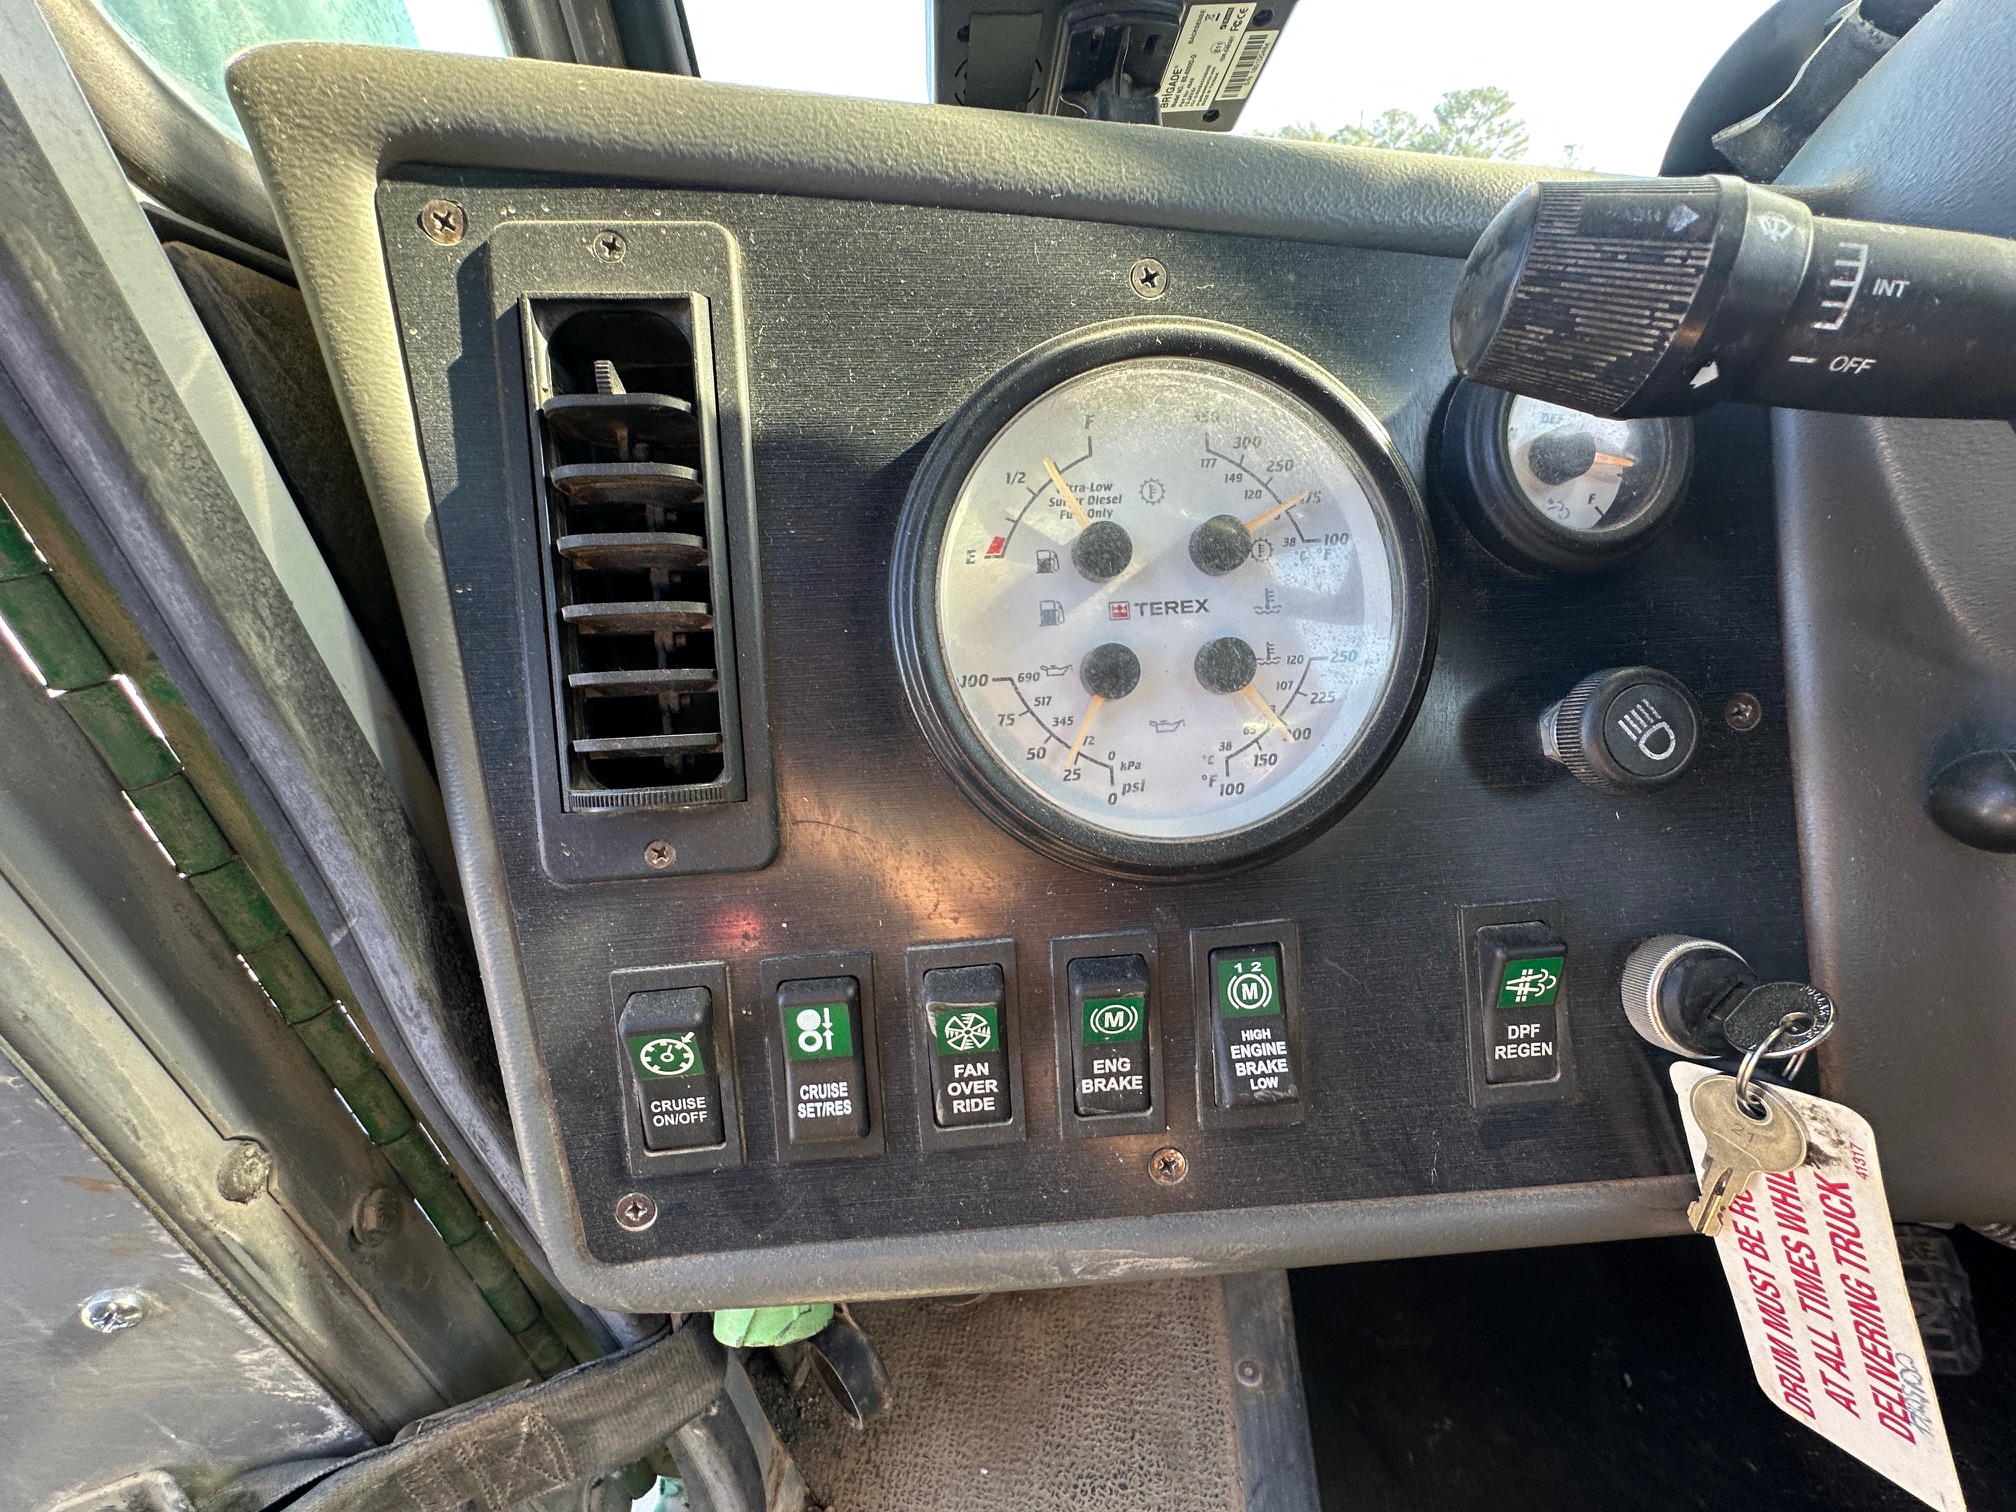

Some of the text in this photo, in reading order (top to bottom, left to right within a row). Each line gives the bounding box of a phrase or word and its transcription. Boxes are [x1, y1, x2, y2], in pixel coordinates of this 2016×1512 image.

[1160, 68, 1183, 108] BRIGADE
[1872, 279, 1909, 298] INT
[1829, 356, 1876, 374] OFF
[1233, 436, 1262, 449] 300
[1201, 458, 1217, 468] 177
[1266, 459, 1294, 473] 250
[1006, 471, 1026, 485] 1/2
[1224, 473, 1243, 483] 149
[1056, 483, 1113, 494] tra-Low
[1244, 490, 1262, 499] 120
[1088, 494, 1122, 505] Diesel
[1588, 493, 1595, 504] F
[1087, 508, 1113, 519] Only
[1283, 537, 1296, 547] 38
[1324, 533, 1350, 546] 100
[1134, 599, 1210, 617] TEREX
[1286, 655, 1304, 665] 120
[1330, 650, 1358, 663] 250
[962, 674, 989, 687] 100
[1018, 672, 1040, 682] 690
[1276, 681, 1293, 690] 107
[1034, 696, 1052, 706] 517
[1310, 692, 1336, 704] 225
[998, 714, 1015, 726] 75
[1052, 716, 1074, 726] 345
[1283, 728, 1312, 742] 00
[1027, 747, 1047, 760] 50
[1219, 742, 1232, 752] 38
[1108, 751, 1116, 760] 0
[1254, 753, 1278, 767] 150
[1120, 761, 1141, 771] kPa
[1063, 768, 1081, 781] 25
[1122, 780, 1146, 795] psi
[1219, 782, 1245, 796] 100
[1108, 793, 1117, 805] 0
[1241, 1028, 1271, 1042] HIGH
[1508, 1023, 1541, 1040] DPF
[1230, 1041, 1287, 1059] ENGINE
[1495, 1041, 1553, 1060] REGEN
[954, 1062, 989, 1078] FAN
[1093, 1058, 1131, 1074] ENG
[1235, 1058, 1288, 1077] BRAKE
[948, 1078, 998, 1097] OVER
[1081, 1075, 1143, 1094] BRAKE
[1250, 1076, 1278, 1091] LOW
[800, 1082, 848, 1100] CRUISE
[650, 1097, 707, 1113] CRUISE
[798, 1100, 852, 1119] SET/RES
[953, 1097, 995, 1114] RIDE
[653, 1110, 708, 1127] ON/OFF
[1849, 1142, 1869, 1181] 41317
[1813, 1171, 1870, 1275] TRUCK
[1732, 1219, 1771, 1263] BE
[1745, 1258, 1792, 1338] MUST
[1764, 1171, 1861, 1419] AT ALL TIMES WHIL
[1840, 1274, 1917, 1445] DELIVERING
[1769, 1333, 1816, 1420] DRUM
